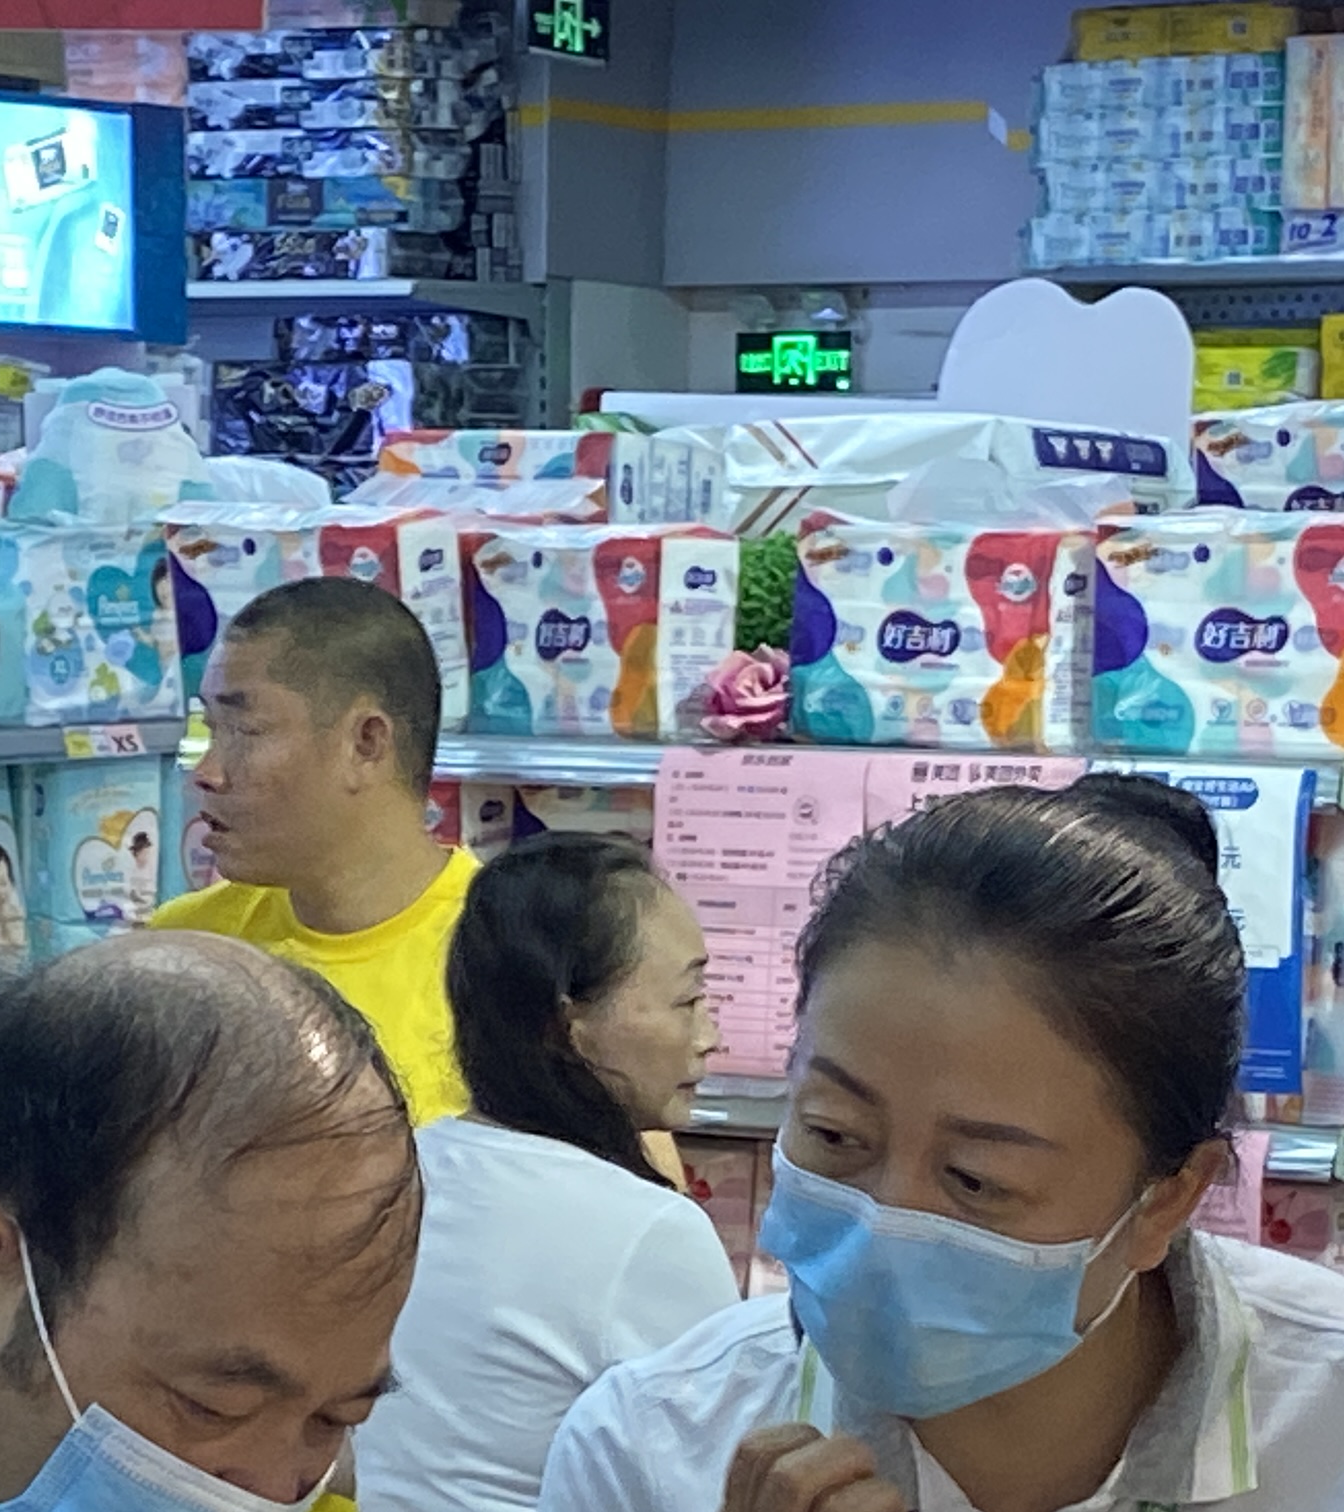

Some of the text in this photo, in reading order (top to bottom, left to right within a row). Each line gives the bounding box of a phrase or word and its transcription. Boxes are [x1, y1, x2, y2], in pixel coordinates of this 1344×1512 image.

[1200, 621, 1285, 650] 好吉利
[111, 733, 140, 753] XS
[1220, 846, 1242, 870] 元
